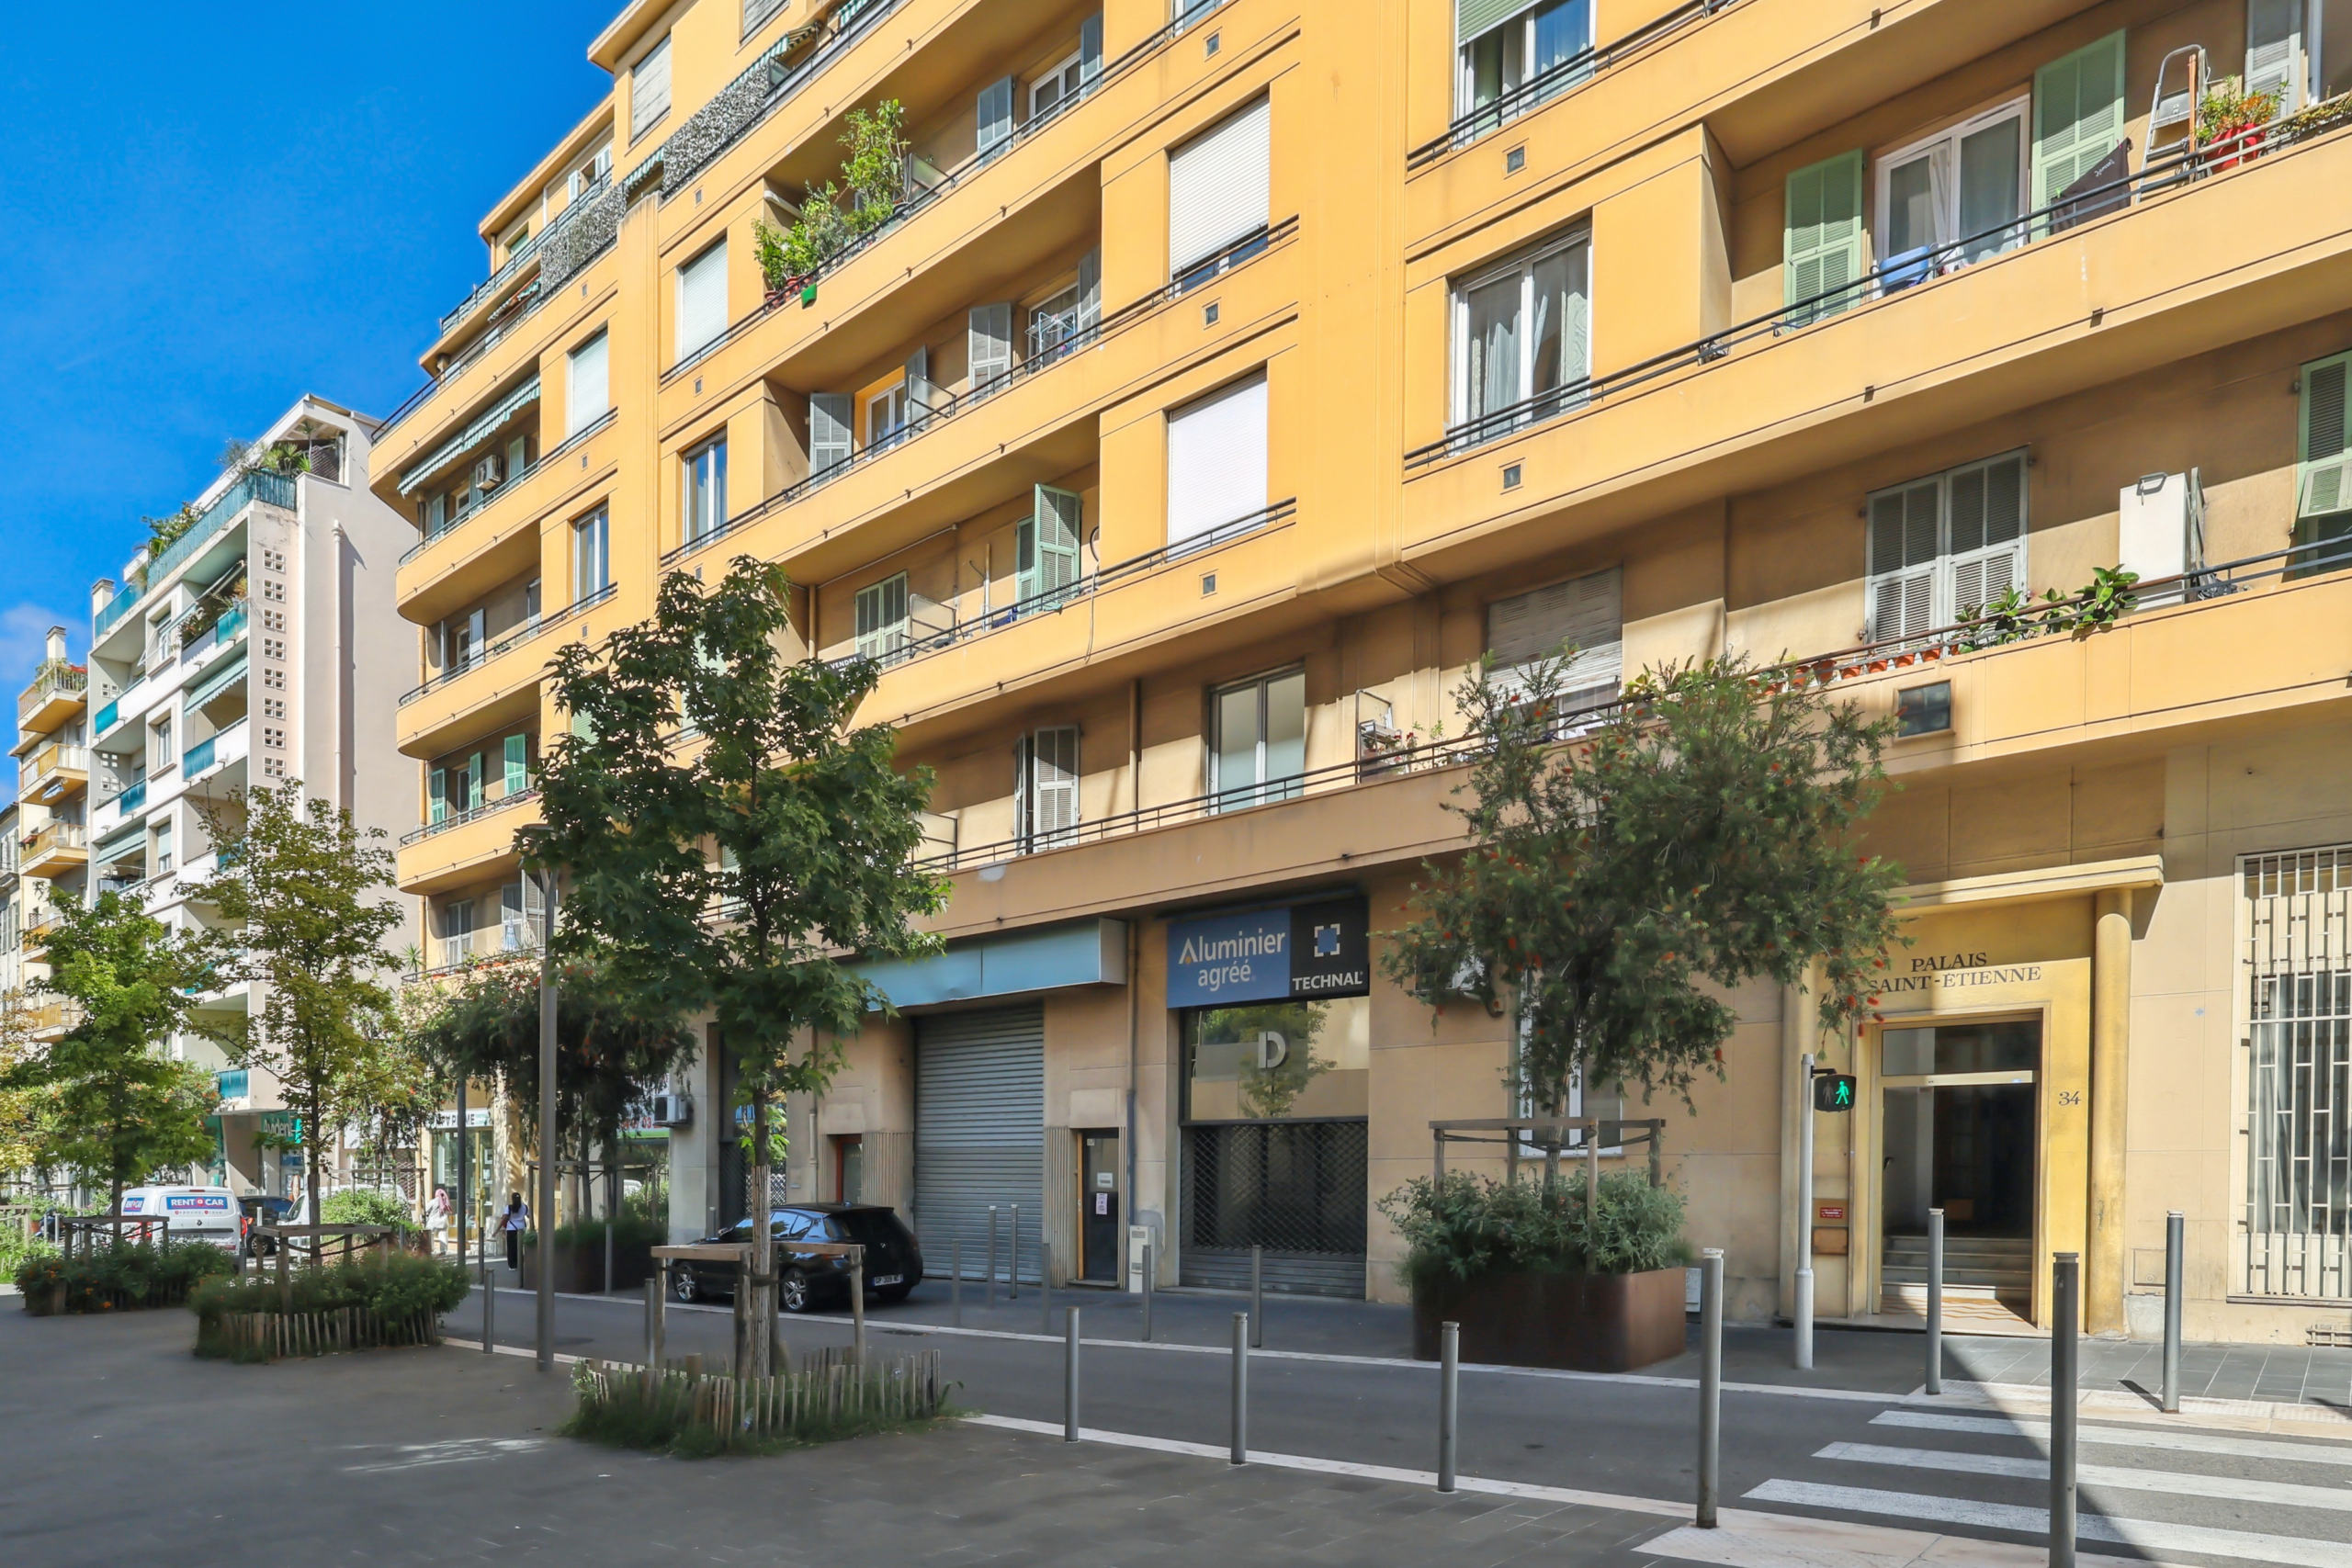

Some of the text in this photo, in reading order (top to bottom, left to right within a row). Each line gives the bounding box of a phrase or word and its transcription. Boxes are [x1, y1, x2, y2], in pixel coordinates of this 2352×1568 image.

[830, 657, 858, 670] VENDRE
[1178, 928, 1285, 964] Aluminier
[1910, 952, 1987, 973] PALAIS
[1197, 959, 1251, 992] agréé
[1292, 971, 1363, 991] TECHNAL
[2058, 1090, 2082, 1106] 34
